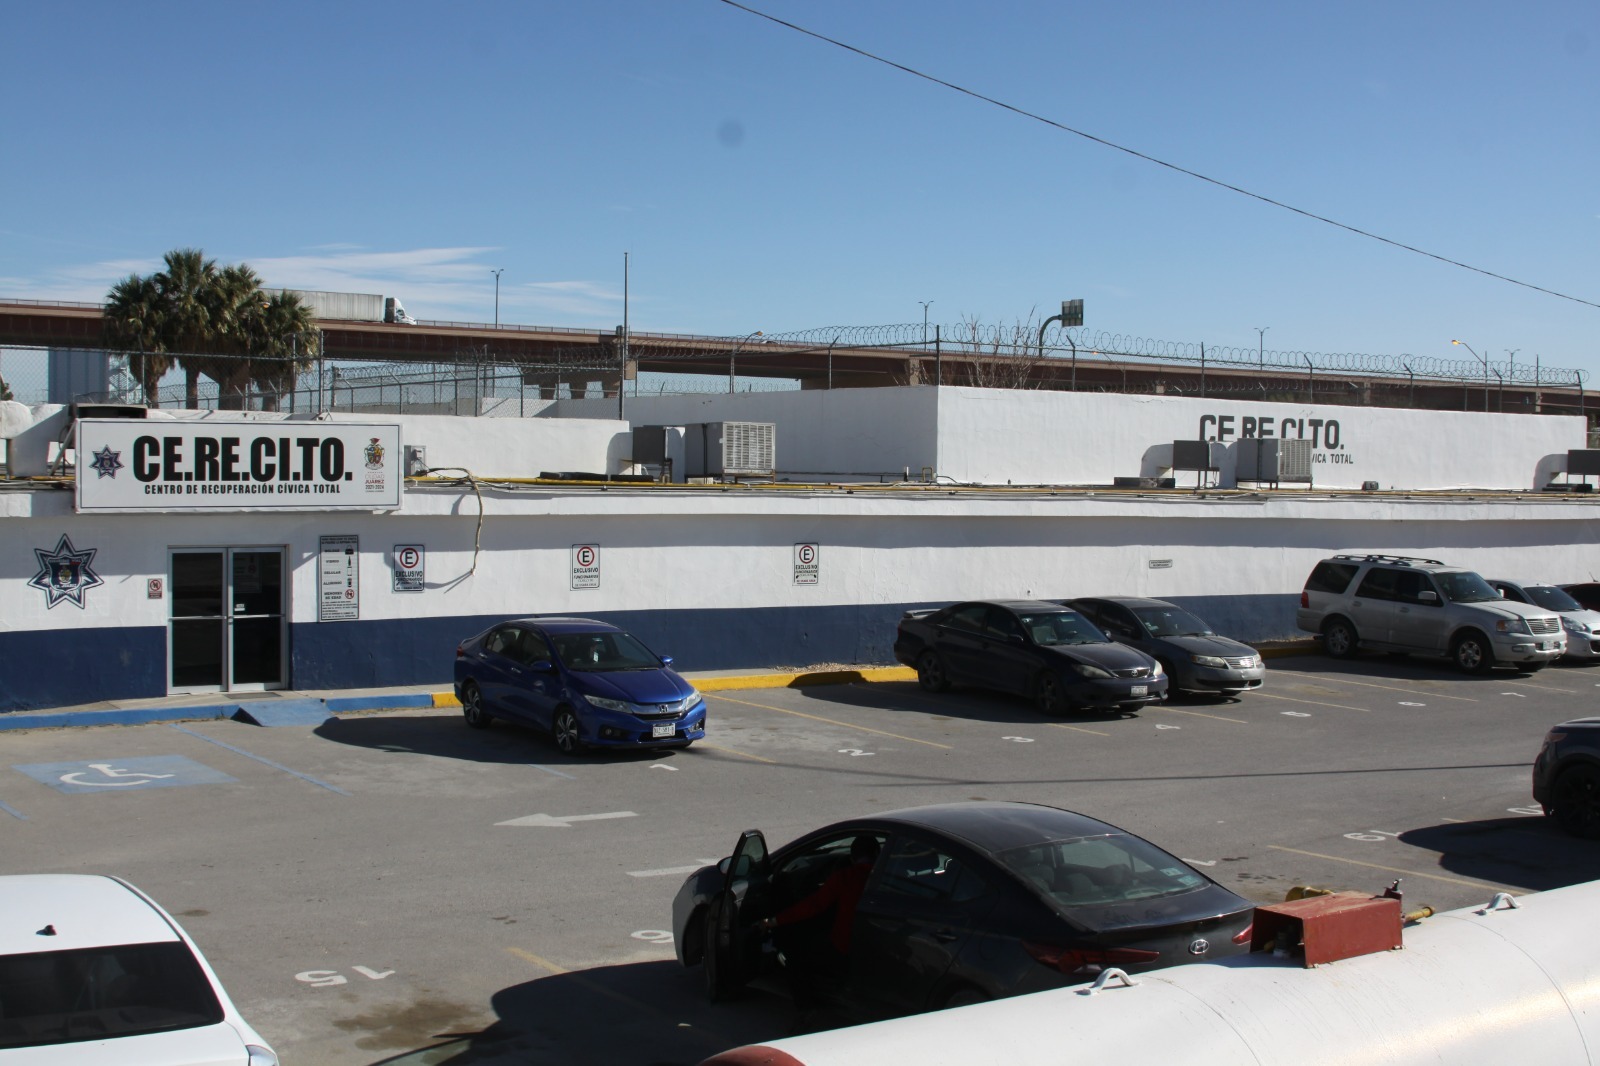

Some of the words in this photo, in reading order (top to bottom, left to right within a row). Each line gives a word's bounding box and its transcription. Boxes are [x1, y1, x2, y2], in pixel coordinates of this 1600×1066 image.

[133, 435, 353, 483] CE.RE.CI.TO.
[1330, 453, 1354, 464] TOTAL
[144, 484, 183, 494] CENTRO
[186, 484, 198, 494] DE
[201, 483, 274, 494] RECUPERACIÓN
[277, 483, 310, 494] CÍVICA
[313, 484, 340, 494] TOTAL
[838, 748, 876, 757] 2
